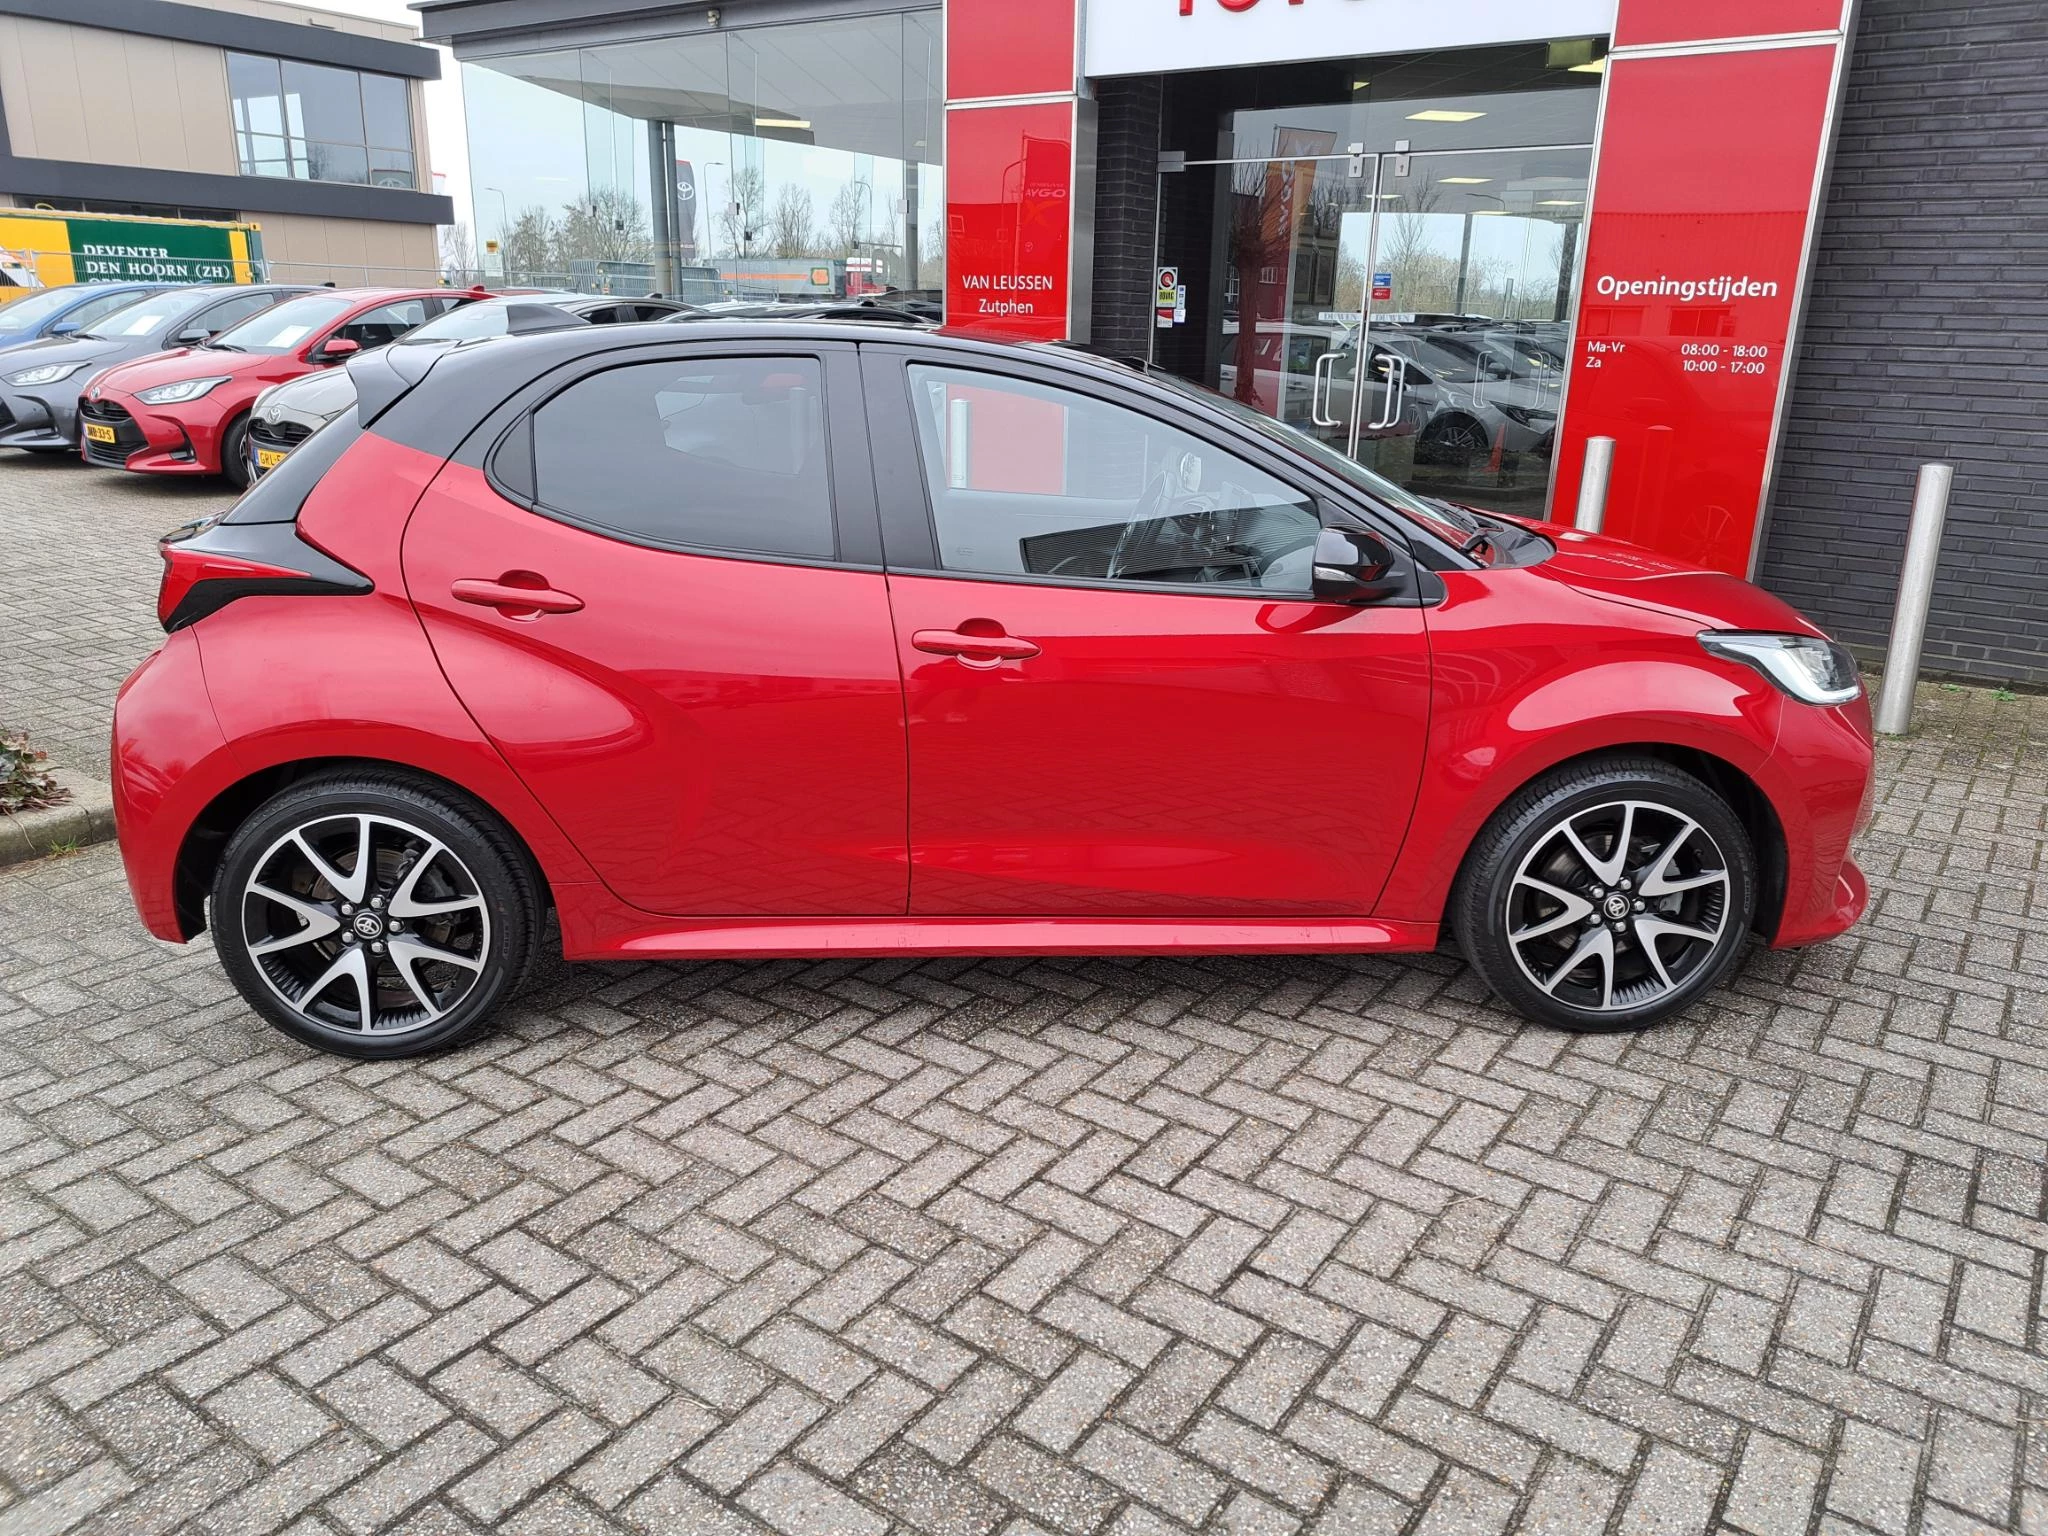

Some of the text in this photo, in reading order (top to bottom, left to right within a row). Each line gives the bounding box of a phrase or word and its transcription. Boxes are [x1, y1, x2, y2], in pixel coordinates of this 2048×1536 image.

[83, 244, 168, 258] DEVENTER
[86, 260, 230, 279] DEN HOORN (ZH)
[962, 275, 1053, 290] VAN LEUSSEN
[1597, 275, 1778, 302] Openingstijden
[979, 298, 1034, 317] Zutphen
[1587, 341, 1626, 353] Ma-Vr
[1681, 343, 1720, 356] 08:00
[1732, 345, 1768, 358] 18:00
[1585, 356, 1602, 369] Za
[1683, 359, 1717, 372] 10:00
[1730, 361, 1765, 374] 17:00
[259, 451, 282, 466] GRL-5
